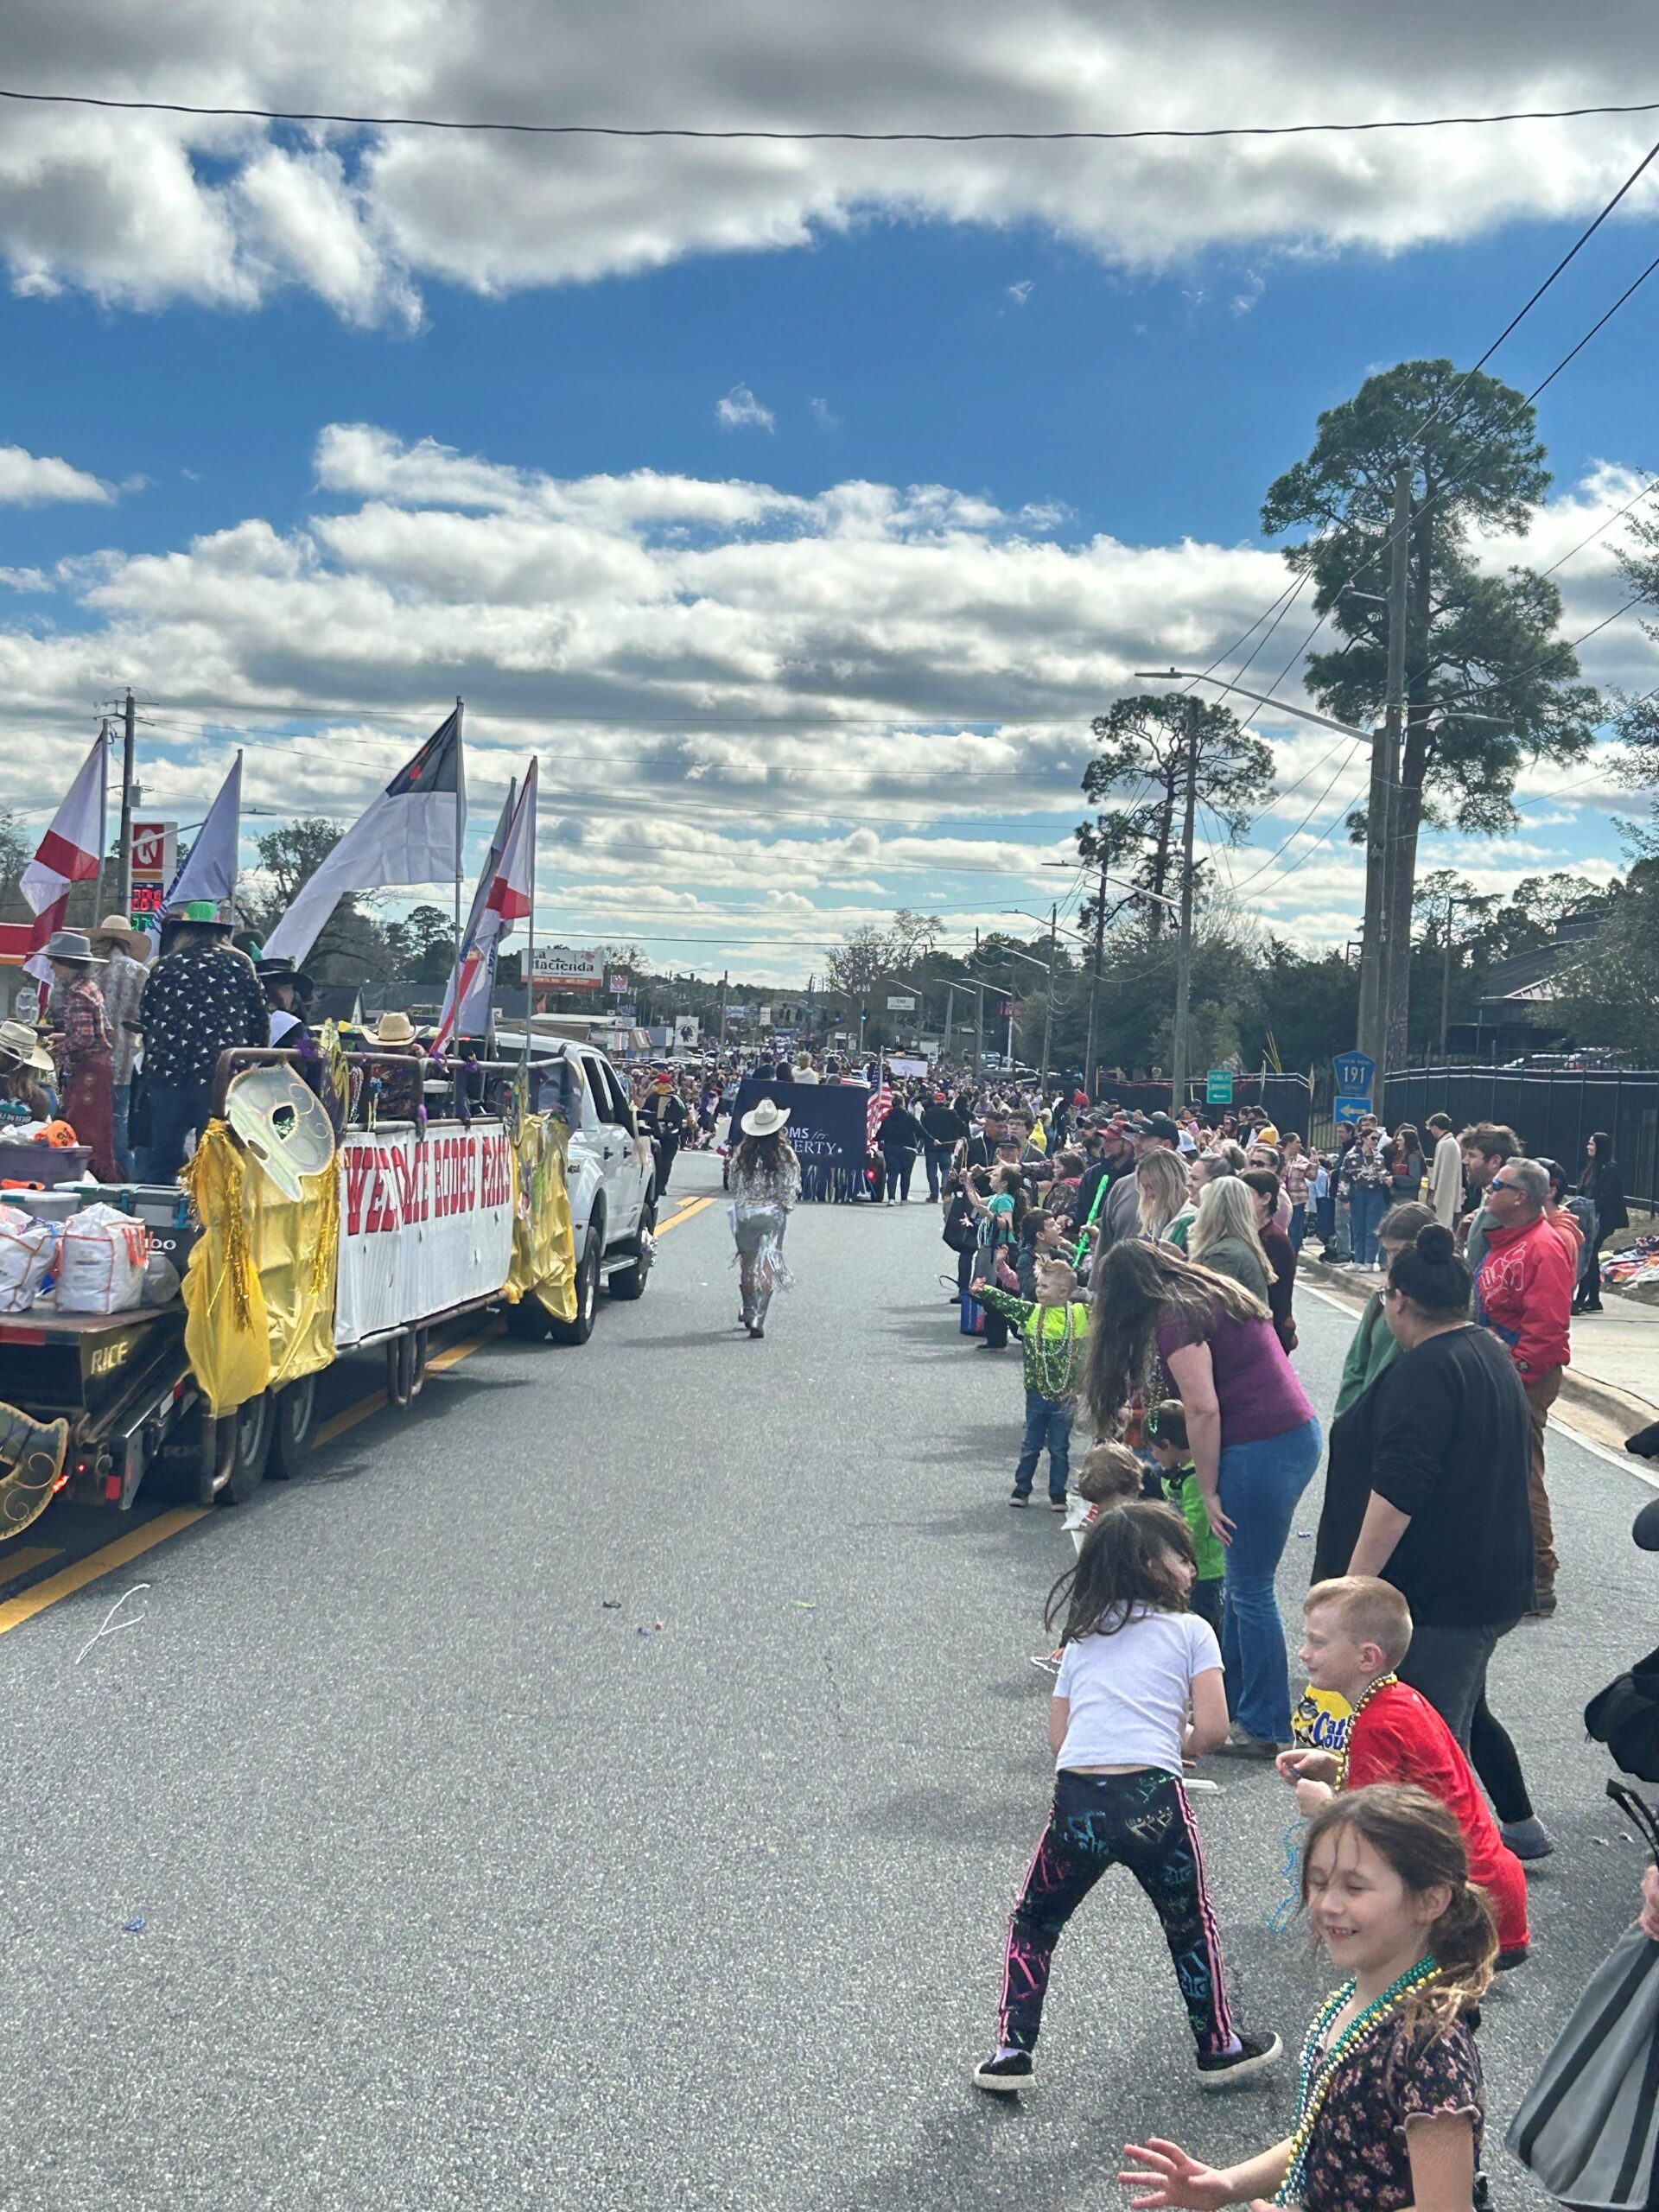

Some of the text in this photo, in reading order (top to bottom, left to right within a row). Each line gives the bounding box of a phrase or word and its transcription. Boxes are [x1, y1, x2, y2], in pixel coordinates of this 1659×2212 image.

[1344, 1065, 1365, 1084] 191
[434, 1137, 476, 1217] RODEO
[91, 1341, 129, 1375] RICE
